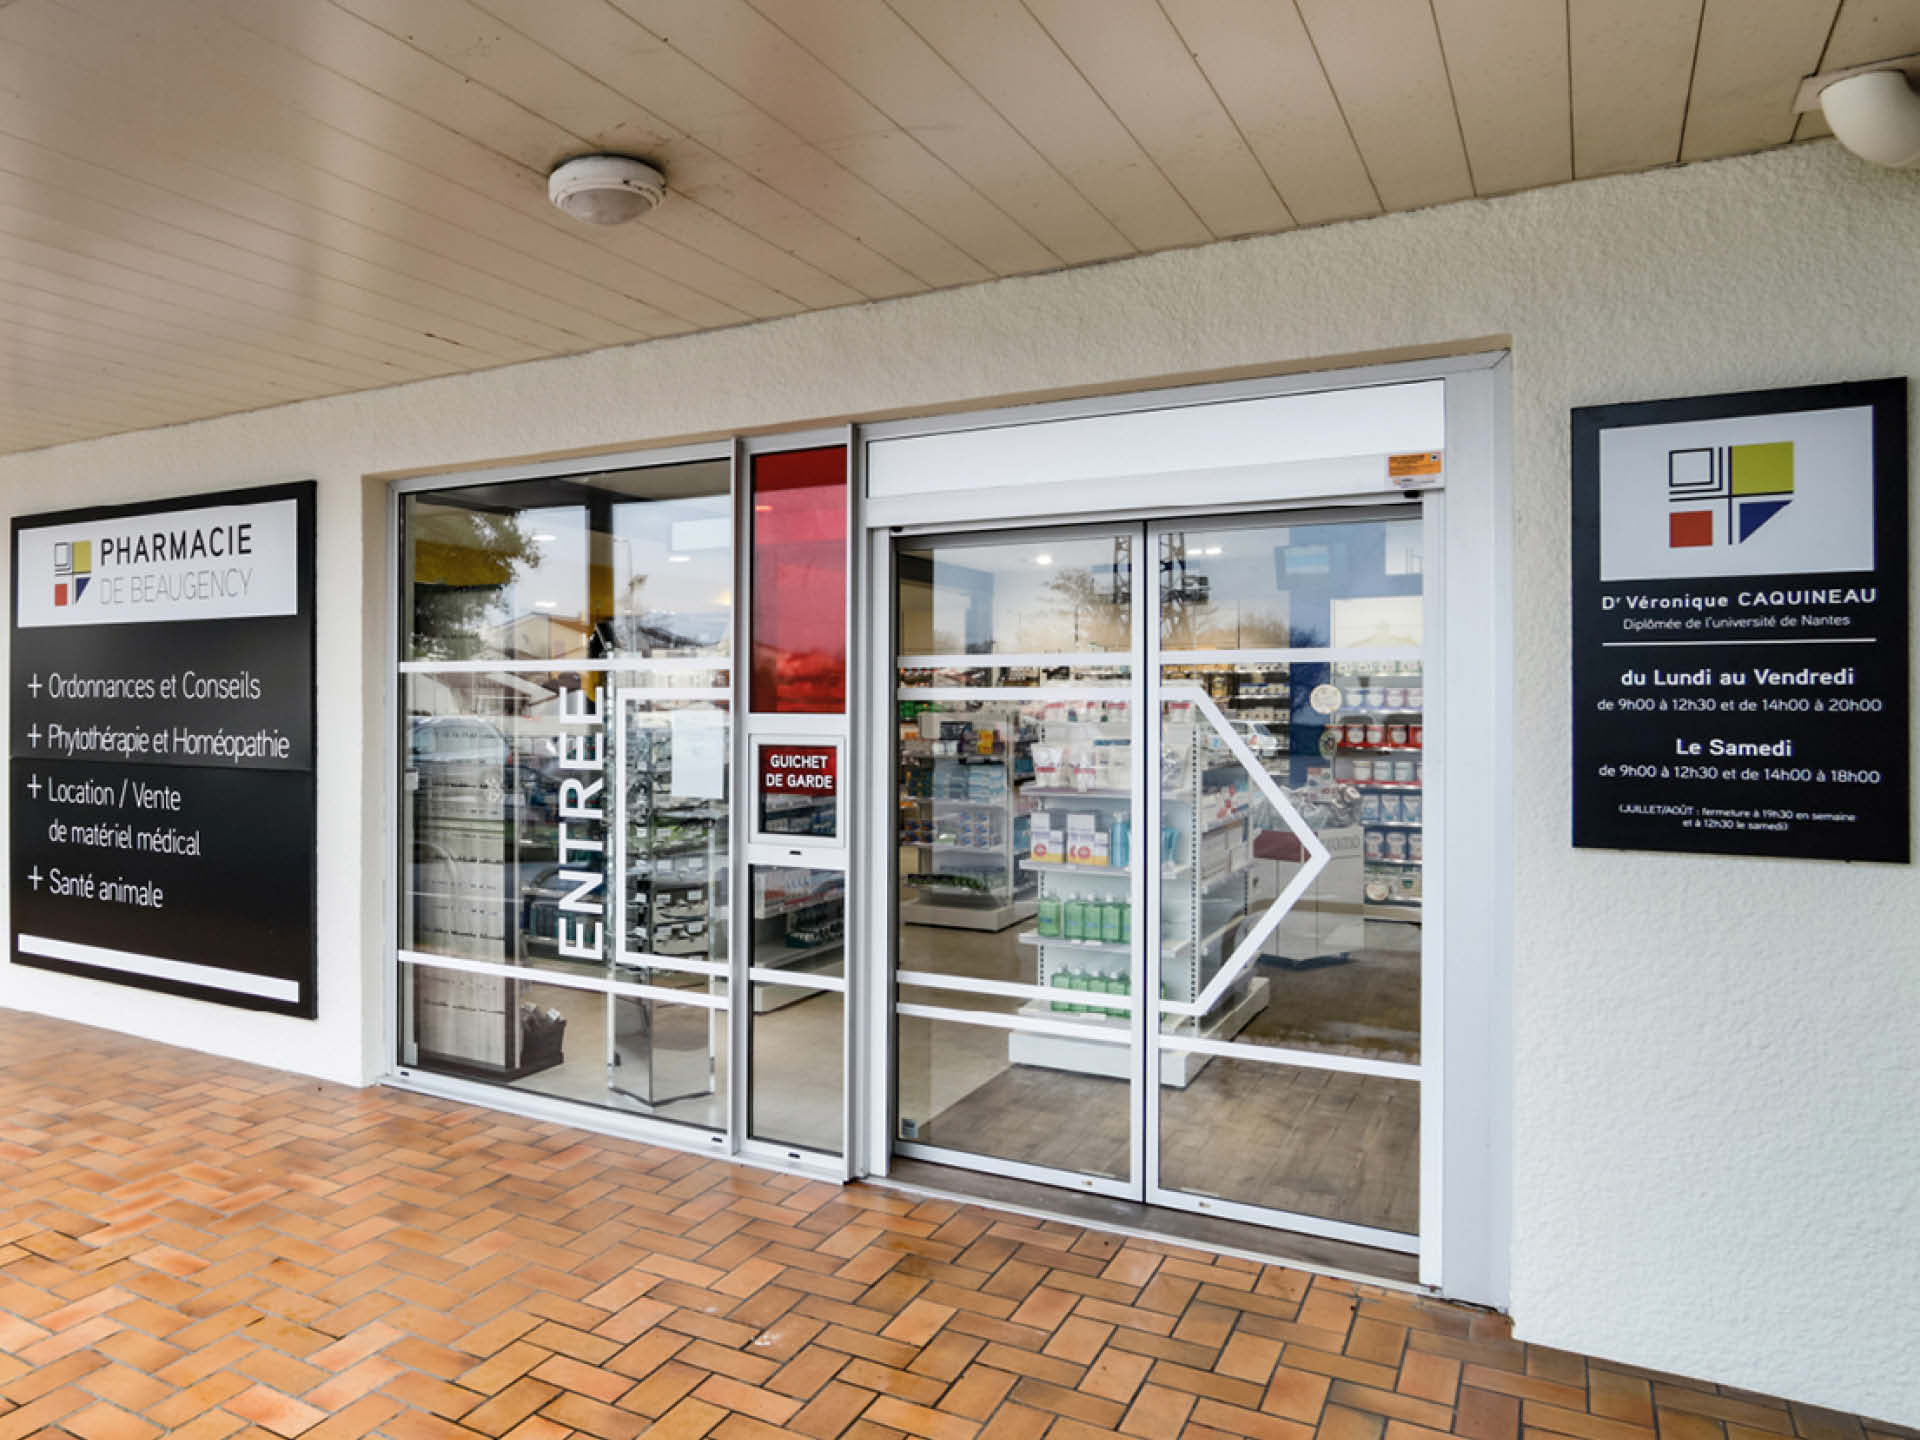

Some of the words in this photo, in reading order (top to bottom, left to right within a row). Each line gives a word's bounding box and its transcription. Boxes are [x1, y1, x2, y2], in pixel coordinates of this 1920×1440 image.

[101, 523, 252, 566] PHARMACIE
[100, 576, 124, 605] DE
[131, 568, 253, 603] BEAUGENCY
[1626, 593, 1729, 612] Véronique
[1738, 588, 1877, 606] CAQUINEAU
[1623, 618, 1682, 632] Diplômée
[1685, 617, 1702, 629] de
[1780, 615, 1797, 627] de
[1801, 614, 1851, 626] Nantes
[49, 672, 155, 699] Ordonnances
[160, 674, 177, 699] et
[183, 670, 262, 699] Conseils
[1621, 668, 1646, 686] du
[1654, 668, 1712, 686] Lundi
[1720, 672, 1746, 685] au
[1753, 667, 1855, 685] Vendredi
[1597, 698, 1615, 711] de
[1618, 698, 1656, 711] 9h00
[1659, 698, 1668, 711] à
[1672, 698, 1717, 711] 12h30
[1720, 700, 1735, 711] et
[1738, 699, 1758, 712] de
[1763, 698, 1809, 712] 14h00
[1814, 698, 1825, 712] à
[1828, 698, 1882, 712] 20h00
[48, 724, 150, 759] Phytothérapie
[153, 728, 169, 753] et
[173, 727, 290, 764] Homéopathie
[1676, 738, 1702, 755] Le
[1709, 739, 1792, 757] Samedi
[770, 753, 828, 769] GUICHET
[1599, 764, 1616, 777] de
[1619, 764, 1657, 778] 9h00
[1661, 764, 1670, 778] à
[1674, 765, 1719, 779] 12h30
[1722, 767, 1736, 780] et
[1740, 767, 1759, 781] de
[1764, 768, 1812, 781] 14h00
[1816, 769, 1826, 782] à
[1831, 769, 1881, 784] 18h00
[48, 776, 114, 806] Location
[132, 780, 181, 811] Vente
[765, 773, 784, 788] DE
[787, 774, 833, 789] GARDE
[547, 686, 603, 960] ENTRÉE
[49, 818, 67, 843] de
[71, 823, 132, 850] matériel
[137, 827, 201, 856] médical
[49, 867, 94, 900] Santé
[99, 876, 163, 908] animale
